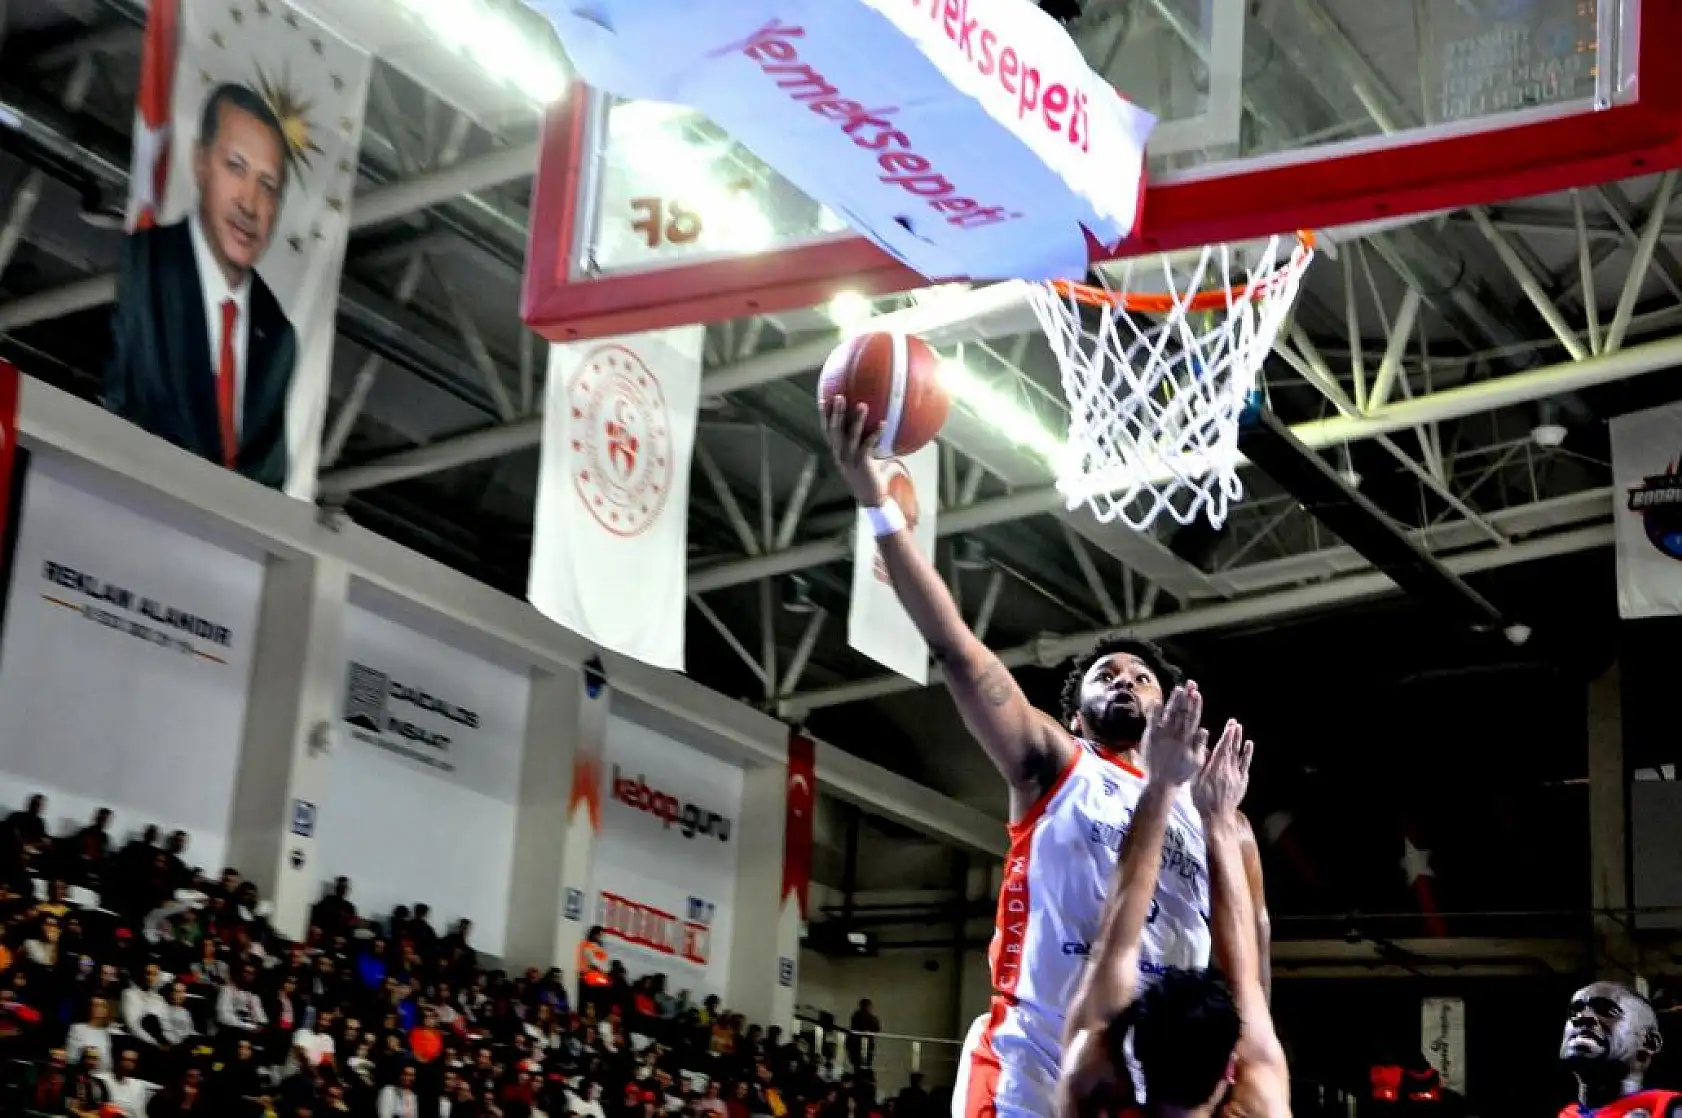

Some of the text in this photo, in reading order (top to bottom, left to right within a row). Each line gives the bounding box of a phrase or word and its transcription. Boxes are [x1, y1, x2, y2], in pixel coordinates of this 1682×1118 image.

[705, 18, 1025, 230] Yemeksepeti
[912, 0, 1089, 153] eksepeti
[611, 763, 730, 842] kebap.guru
